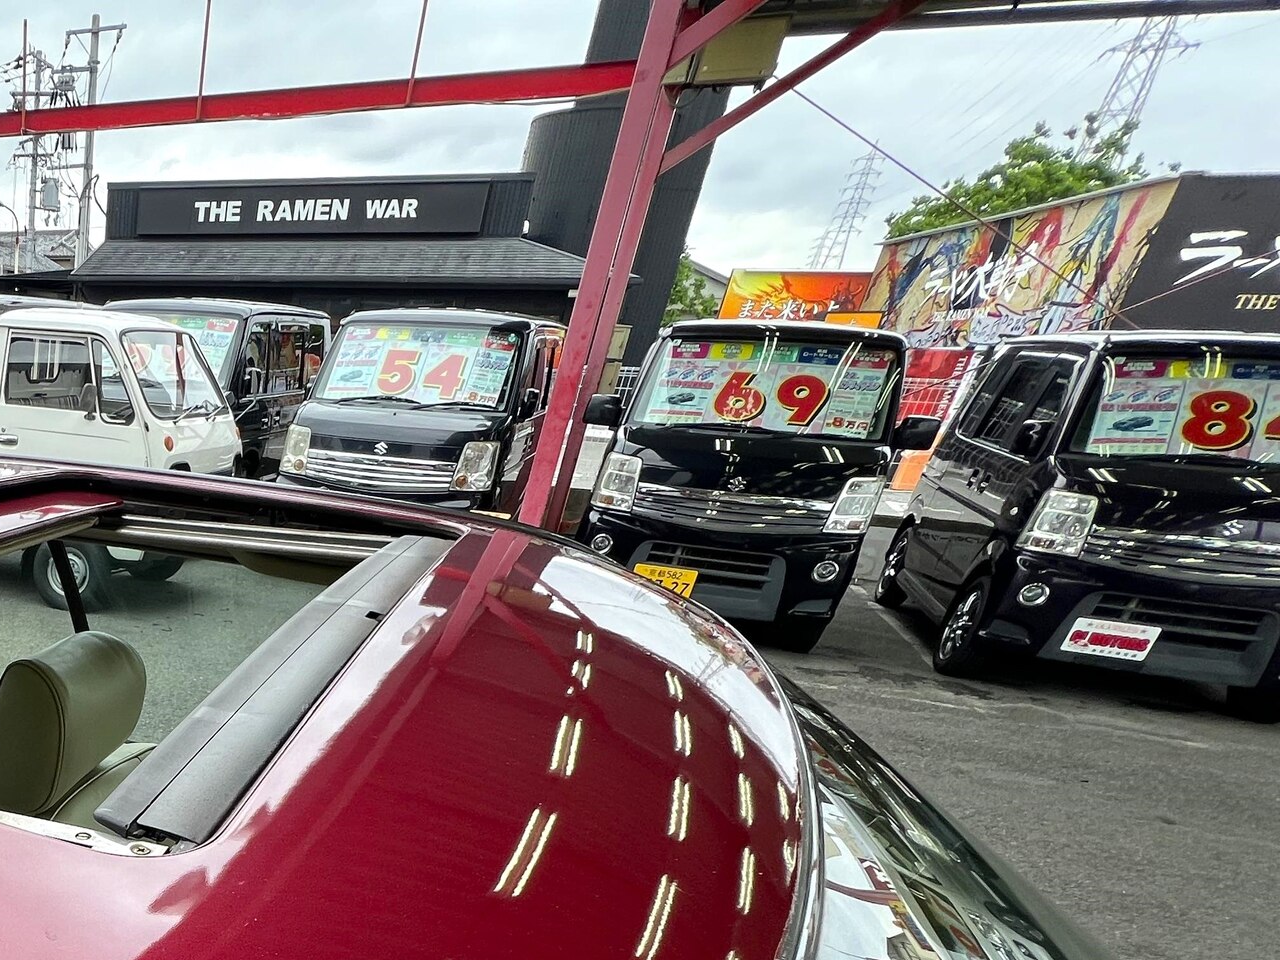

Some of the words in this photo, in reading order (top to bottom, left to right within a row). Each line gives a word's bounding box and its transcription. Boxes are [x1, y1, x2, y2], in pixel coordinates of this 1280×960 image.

[194, 200, 242, 223] THE
[256, 198, 350, 222] RAMEN
[365, 198, 418, 219] WAR
[1234, 293, 1280, 310] THE
[377, 349, 468, 400] 54
[713, 371, 831, 427] 69
[666, 570, 683, 579] 582
